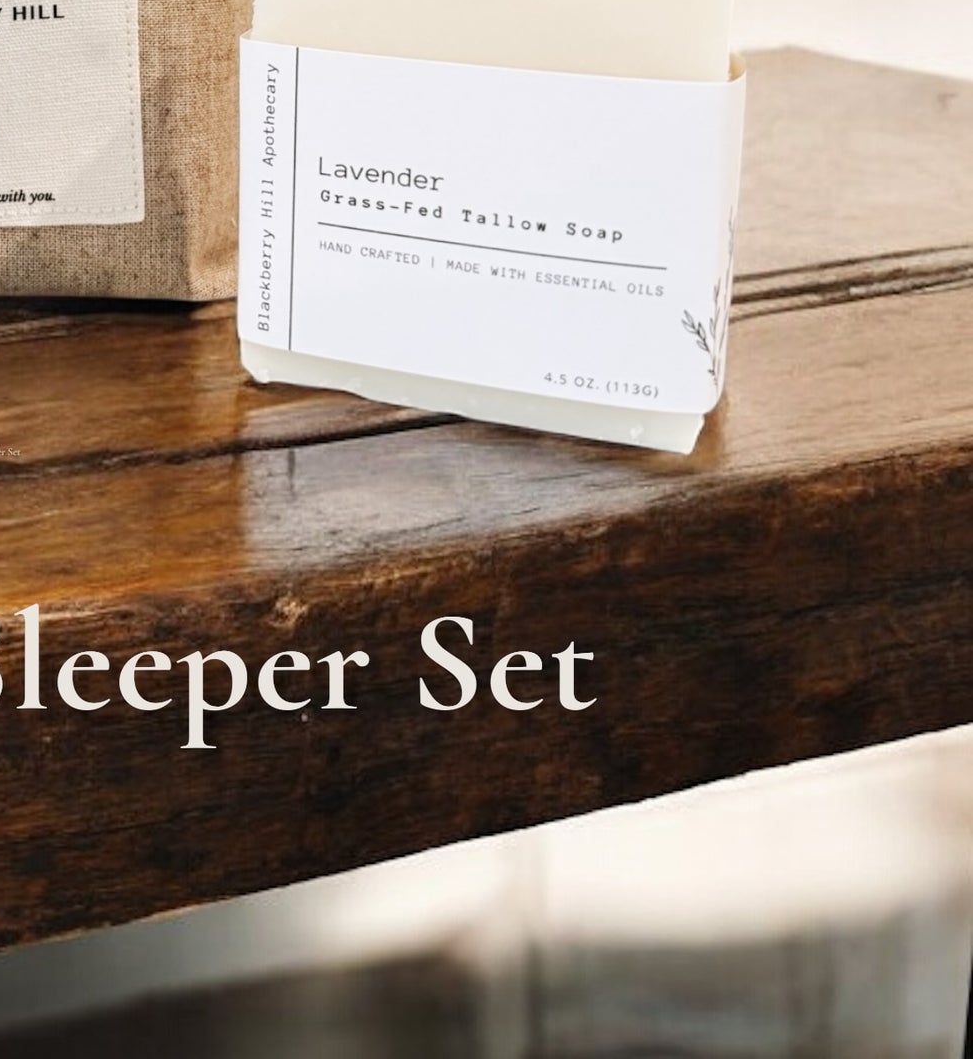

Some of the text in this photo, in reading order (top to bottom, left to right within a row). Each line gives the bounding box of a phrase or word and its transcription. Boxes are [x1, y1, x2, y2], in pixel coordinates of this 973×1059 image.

[12, 4, 65, 21] HILL
[317, 156, 445, 191] Lavender
[29, 190, 56, 205] you.
[258, 63, 279, 332] Blackberry Hill Apothecary
[320, 189, 625, 245] Grass-Fed Tallow Soap
[319, 240, 353, 255] HAND
[360, 245, 421, 266] CRAFTED
[446, 260, 481, 275] MADE
[490, 265, 526, 281] WITH
[535, 271, 617, 293] ESSENTIAL
[627, 282, 665, 297] OILS
[543, 371, 660, 399] 4.5 OZ. (113G)
